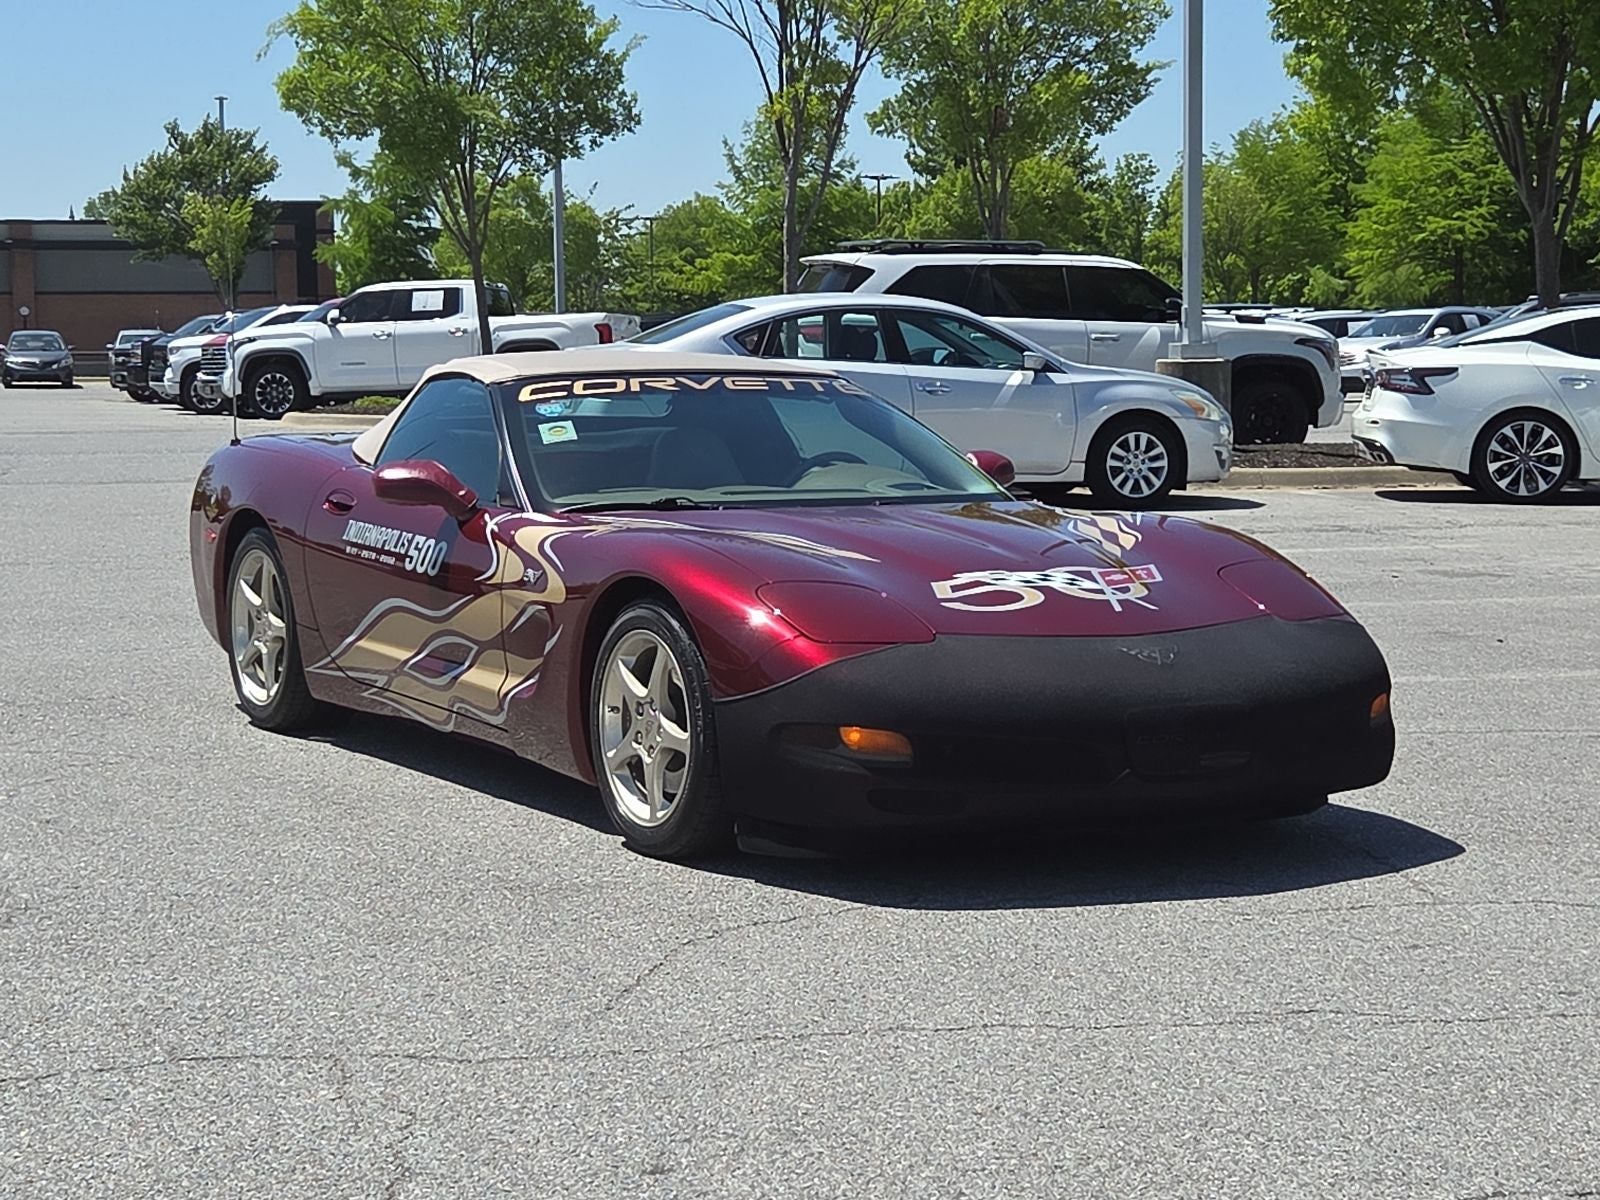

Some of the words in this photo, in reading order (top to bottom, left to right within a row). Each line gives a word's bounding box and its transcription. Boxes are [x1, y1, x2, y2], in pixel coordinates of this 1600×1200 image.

[518, 376, 873, 402] CORVETTE
[342, 519, 413, 554] INDIANAPOLIS
[404, 534, 448, 577] 500
